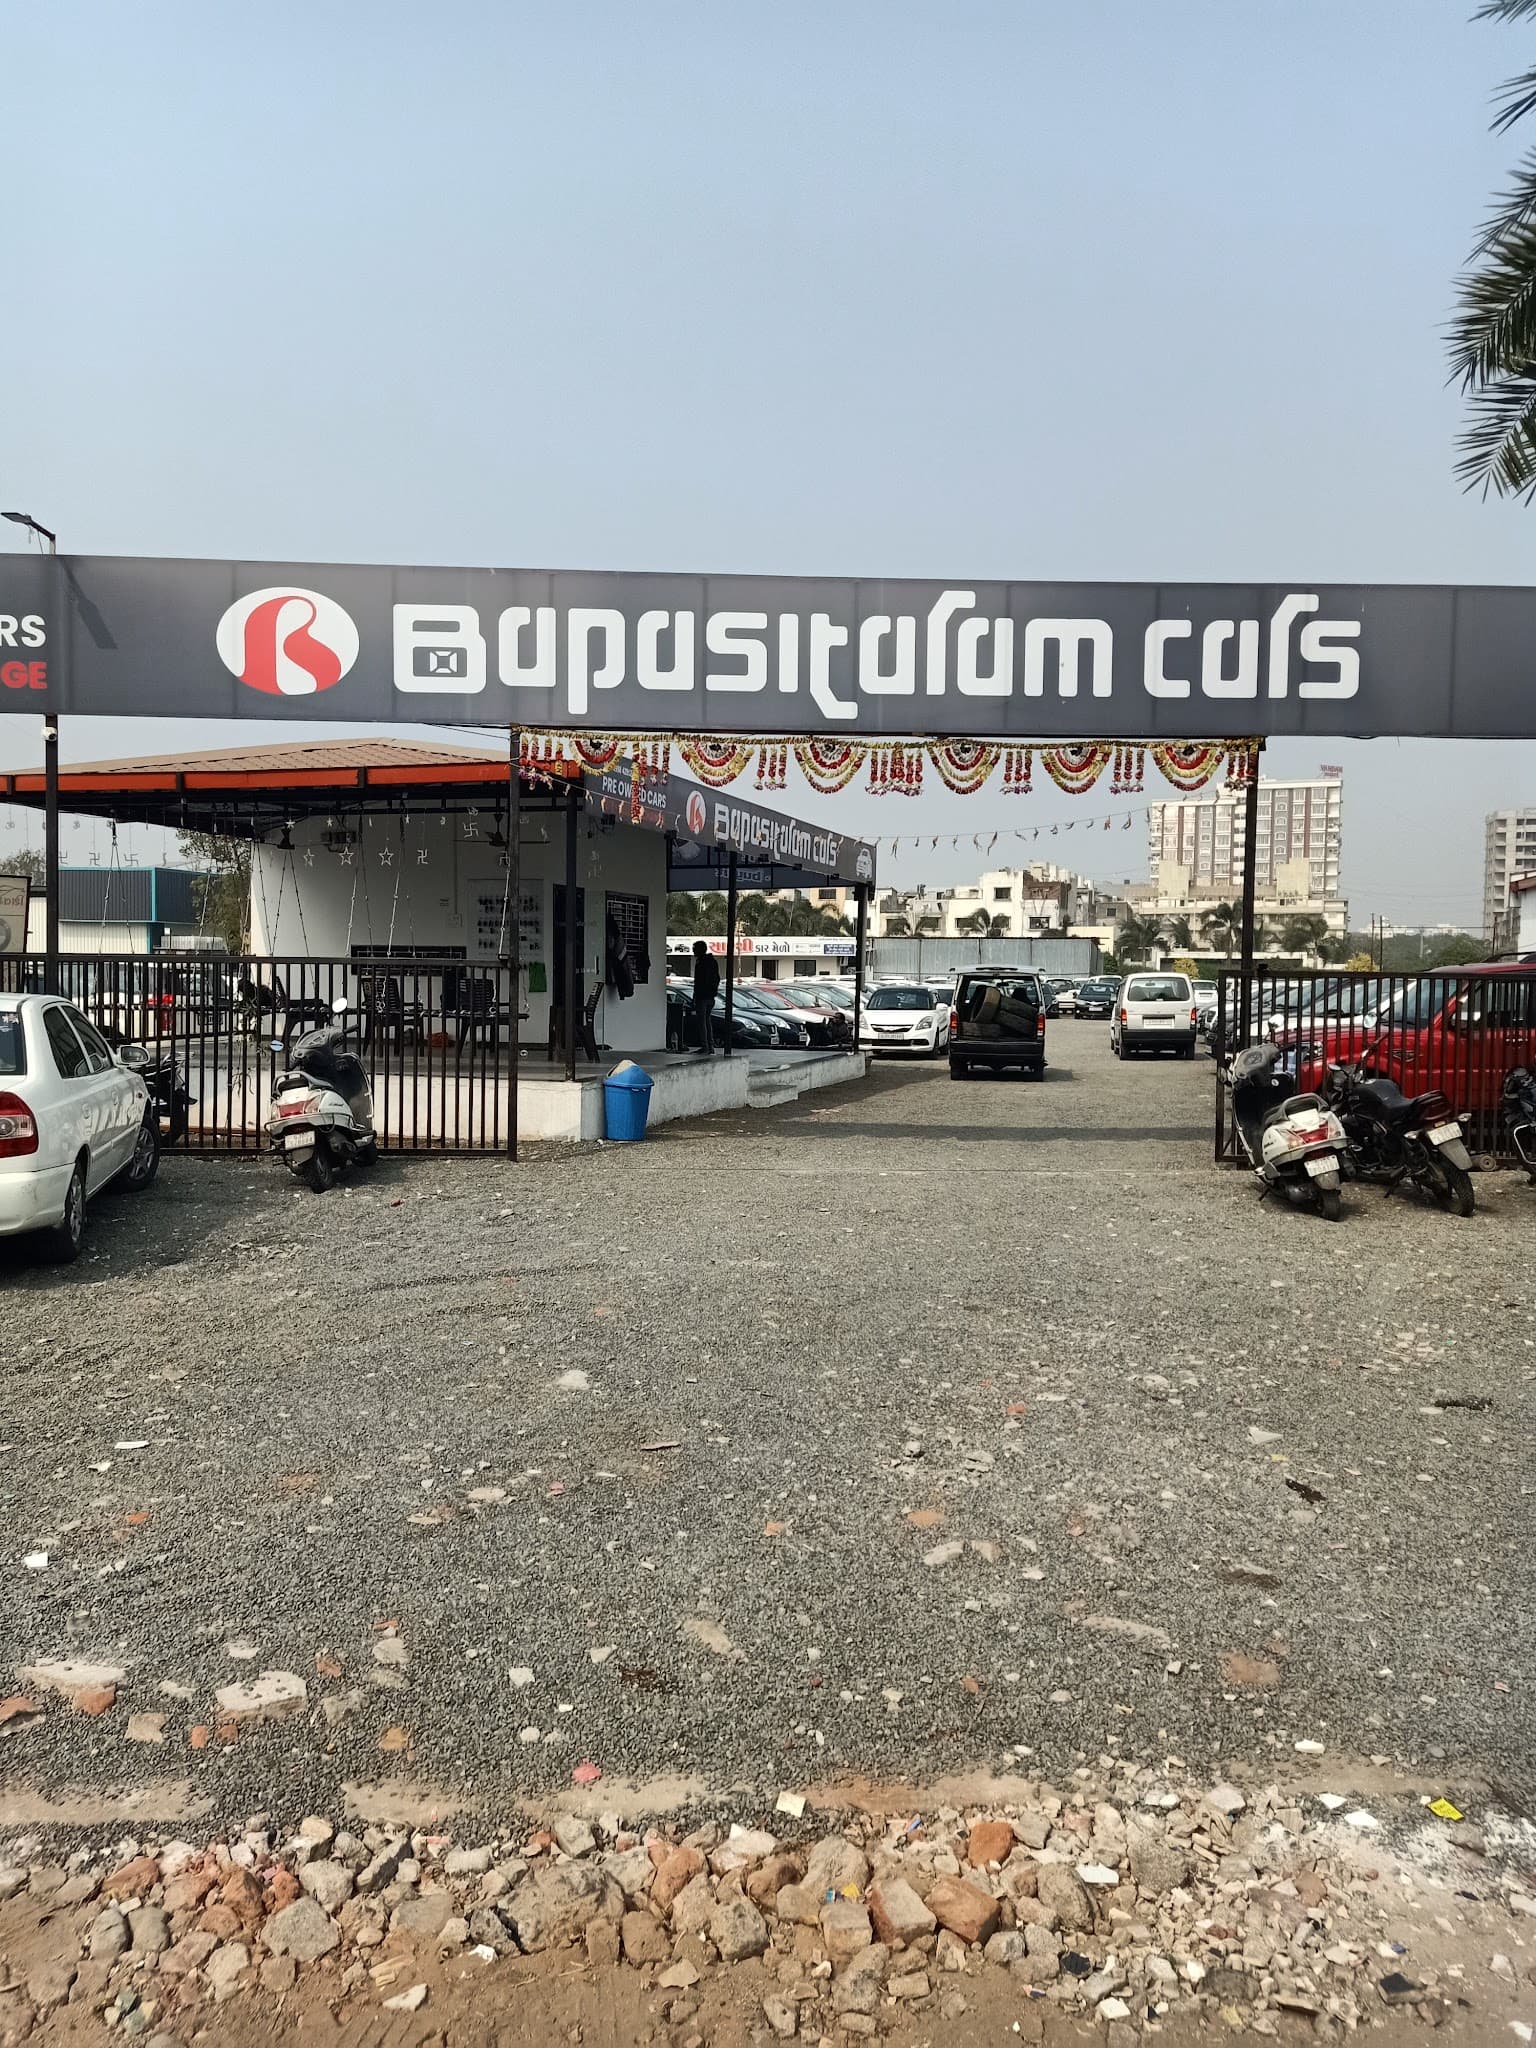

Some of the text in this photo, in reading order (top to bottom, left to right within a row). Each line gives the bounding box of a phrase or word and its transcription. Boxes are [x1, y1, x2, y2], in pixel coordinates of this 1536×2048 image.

[393, 590, 1361, 720] Bapasitaram cars
[602, 775, 618, 795] PRE
[647, 790, 667, 809] CARS
[813, 832, 838, 867] cars
